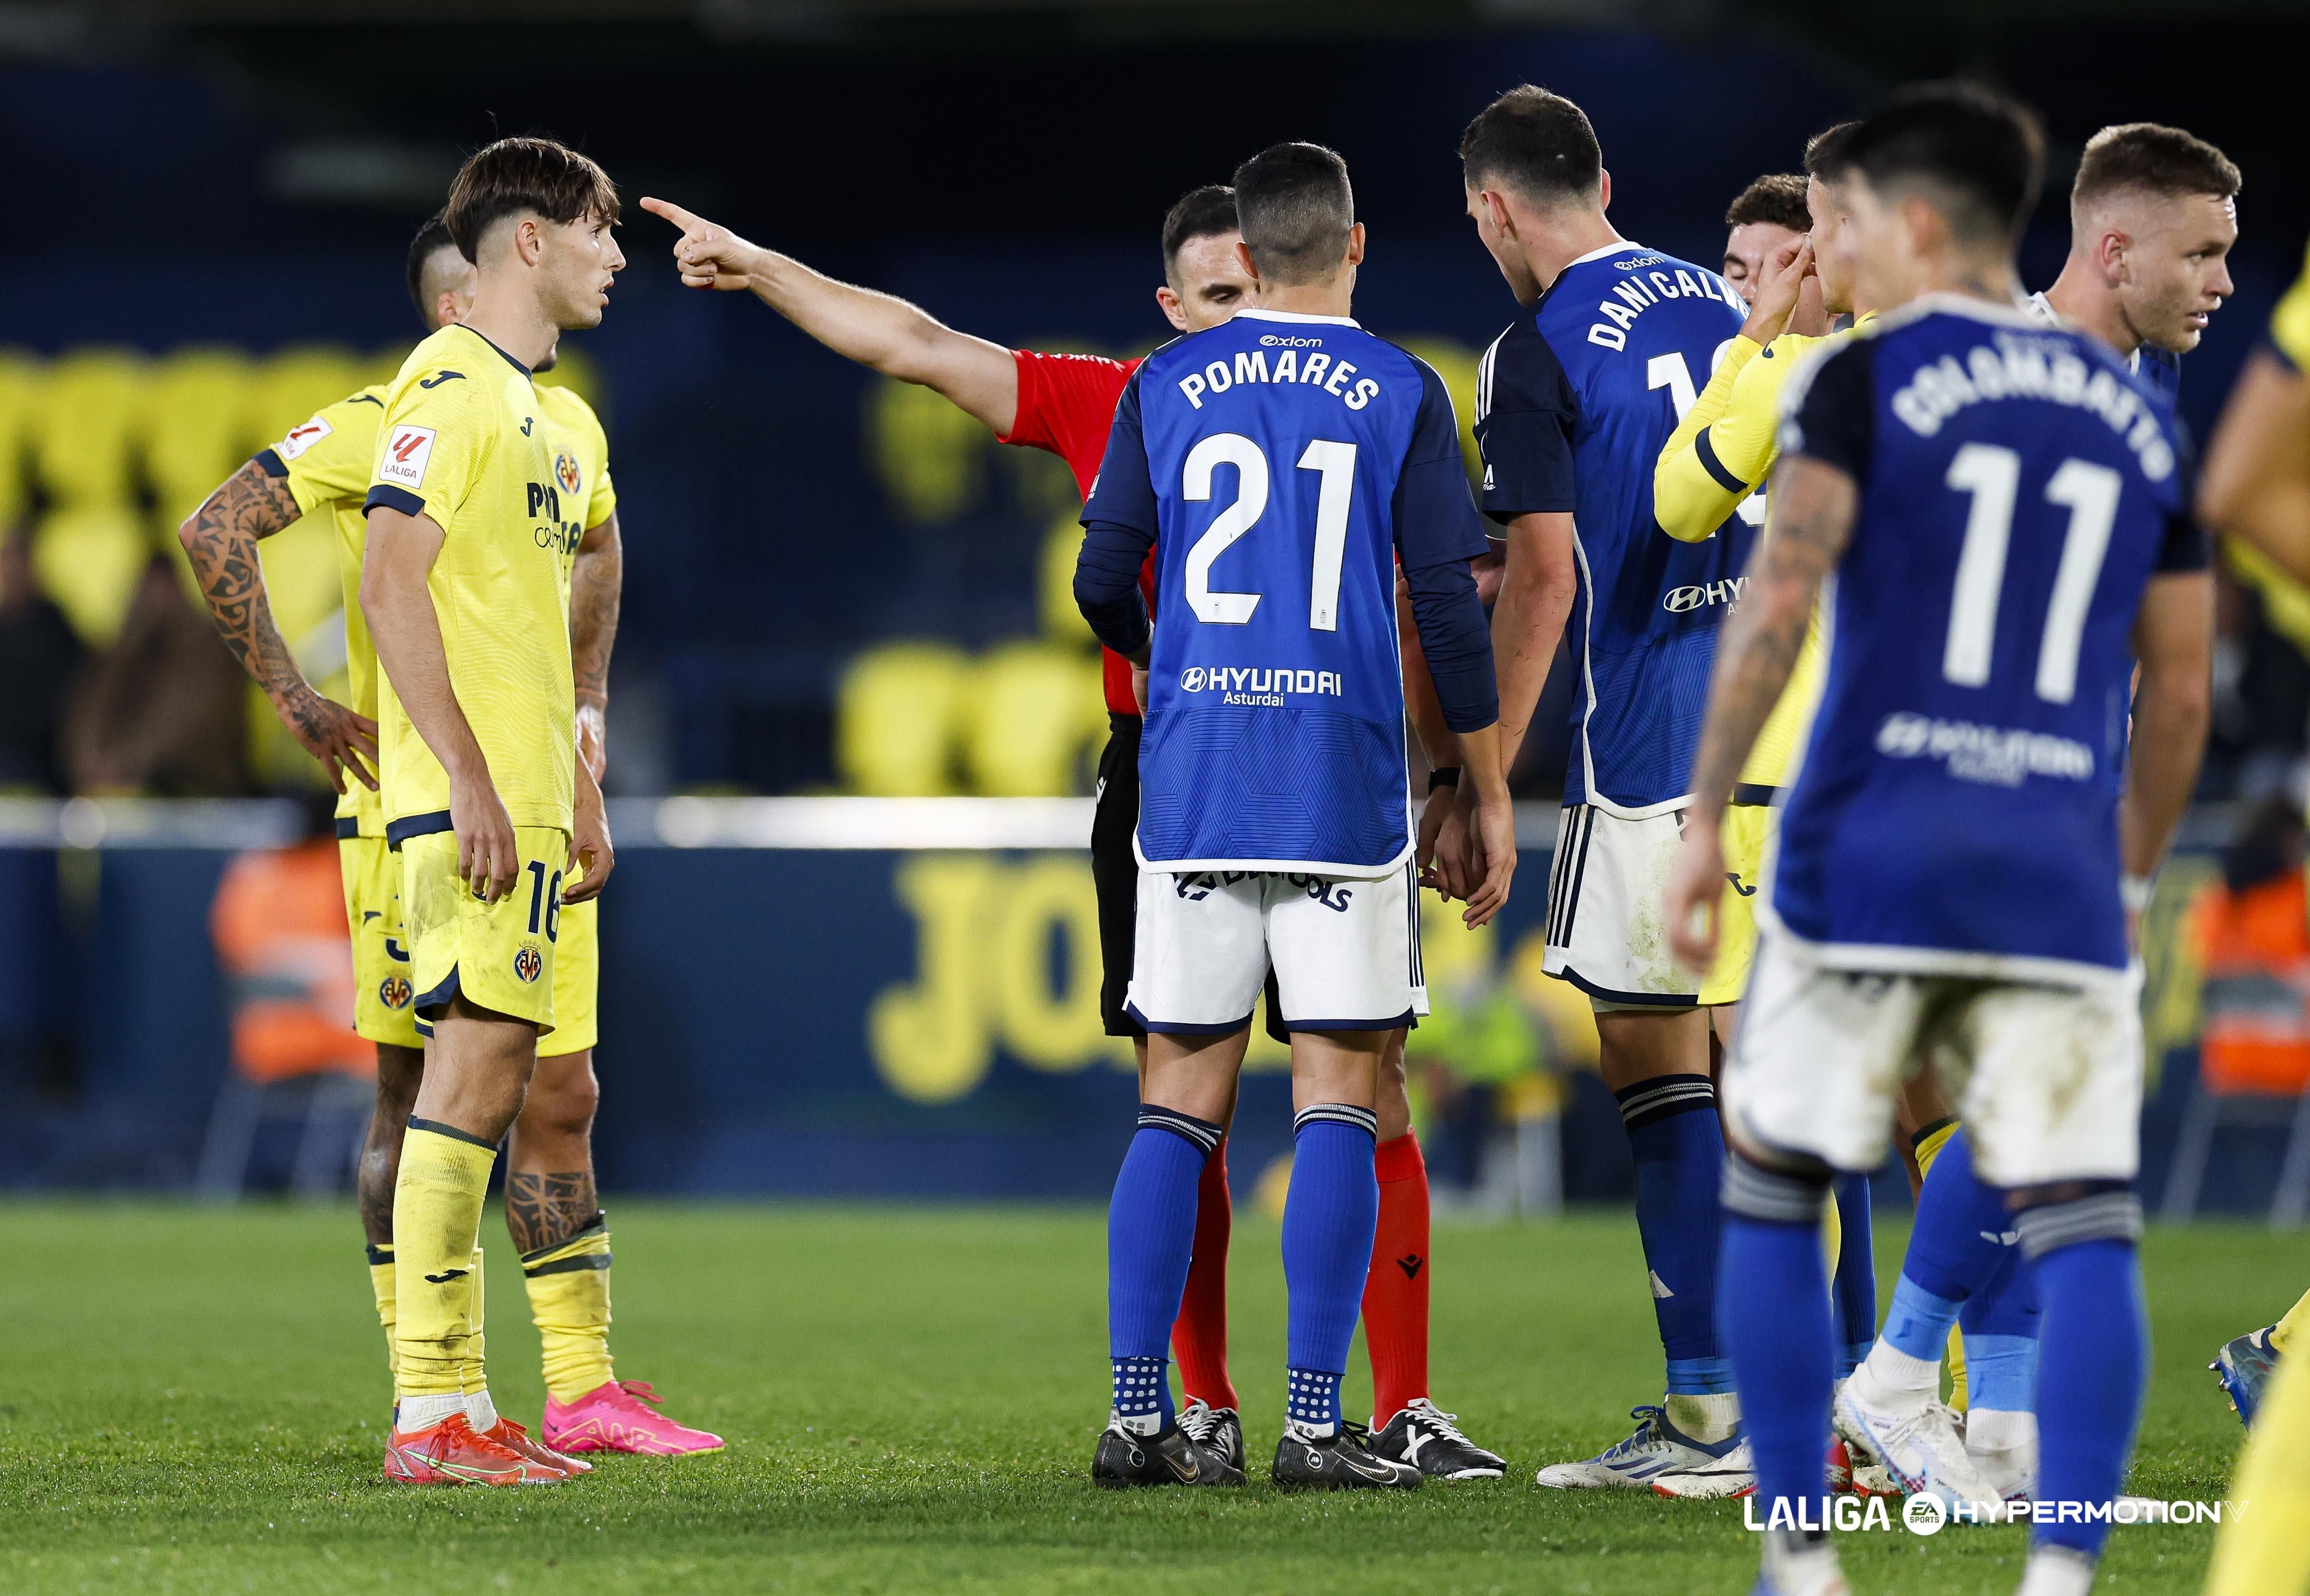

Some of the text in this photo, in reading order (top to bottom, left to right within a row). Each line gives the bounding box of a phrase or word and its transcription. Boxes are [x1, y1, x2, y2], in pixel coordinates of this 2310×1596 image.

[1259, 335, 1323, 347] exiom
[1587, 276, 1659, 352] DANI
[1178, 350, 1379, 410] POMARES
[385, 464, 417, 479] LALIGA
[1183, 432, 1357, 632] 21
[1946, 442, 2123, 706] 11
[1209, 667, 1342, 697] HYUNDAI
[1223, 691, 1285, 707] Asturdai
[527, 860, 562, 943] 16
